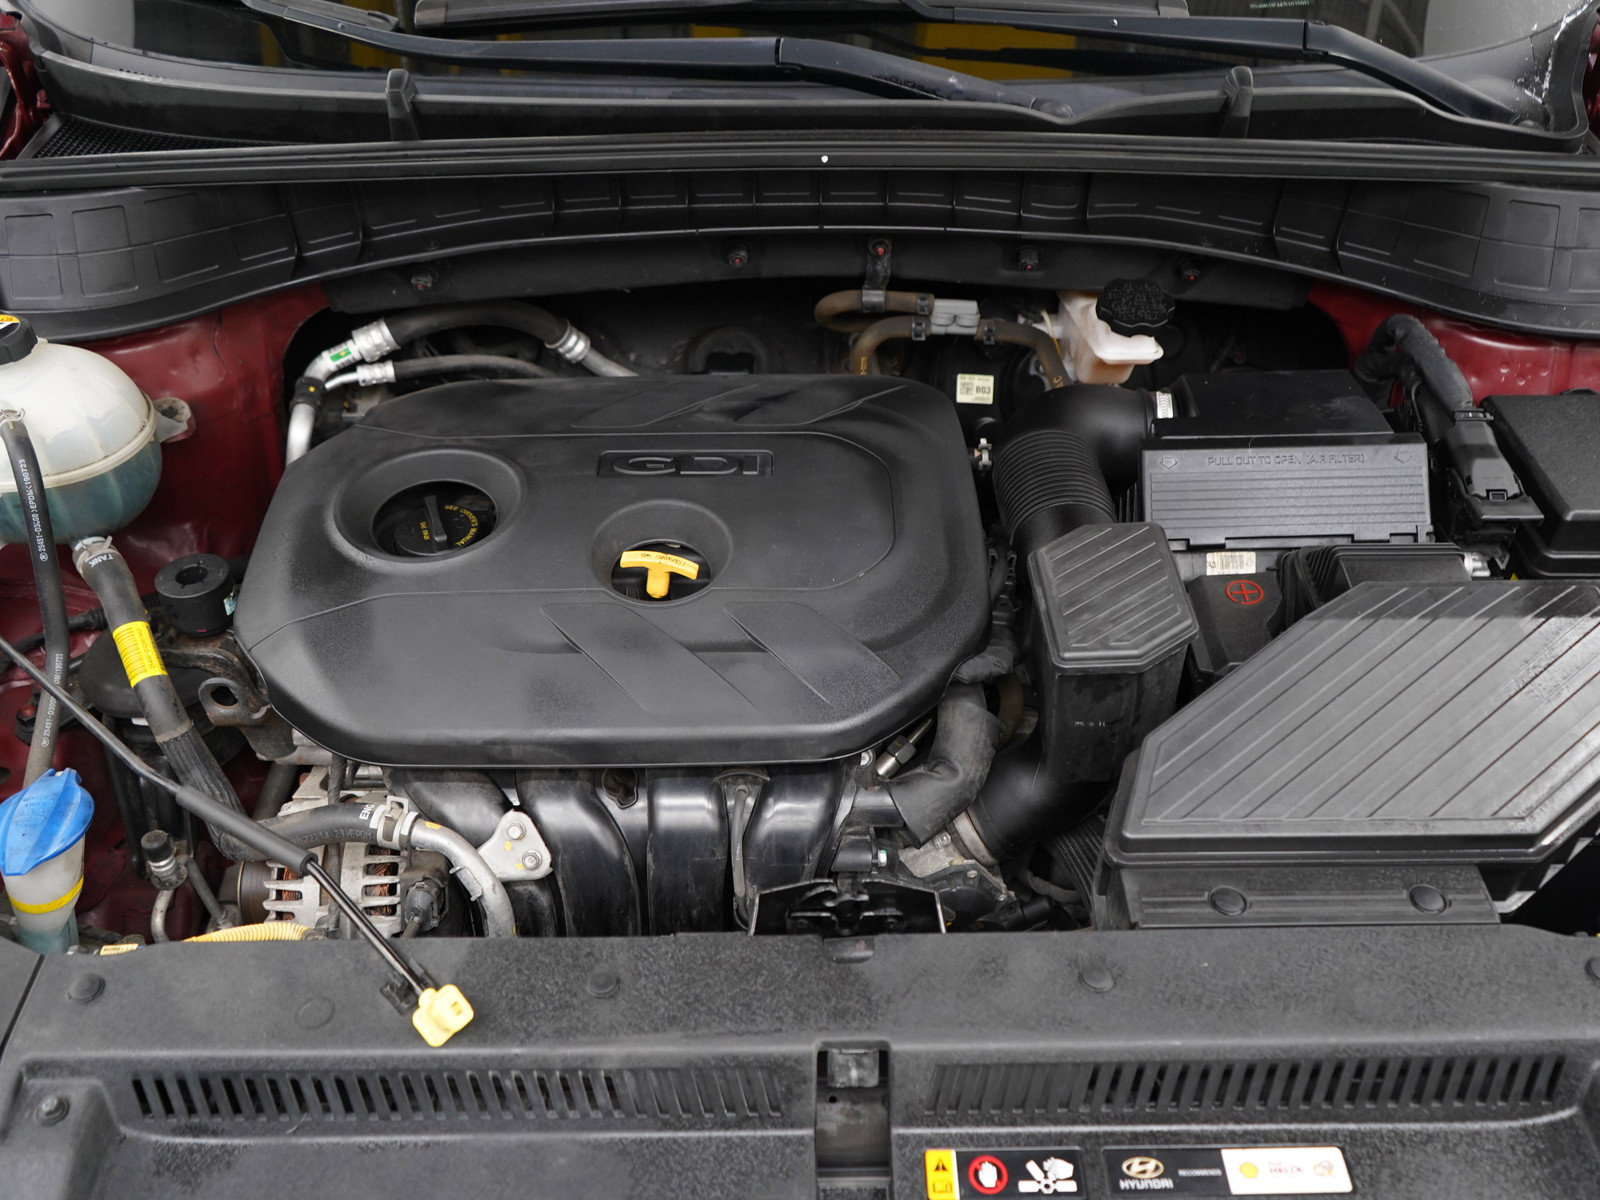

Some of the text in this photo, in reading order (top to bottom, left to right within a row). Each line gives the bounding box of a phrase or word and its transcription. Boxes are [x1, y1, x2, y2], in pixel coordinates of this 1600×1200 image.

[613, 455, 761, 476] GDI
[1207, 456, 1234, 467] PULL
[1236, 455, 1255, 466] OUT
[1258, 455, 1271, 465] TO
[88, 553, 114, 568] TANK
[1118, 1178, 1174, 1190] HYUNDAI
